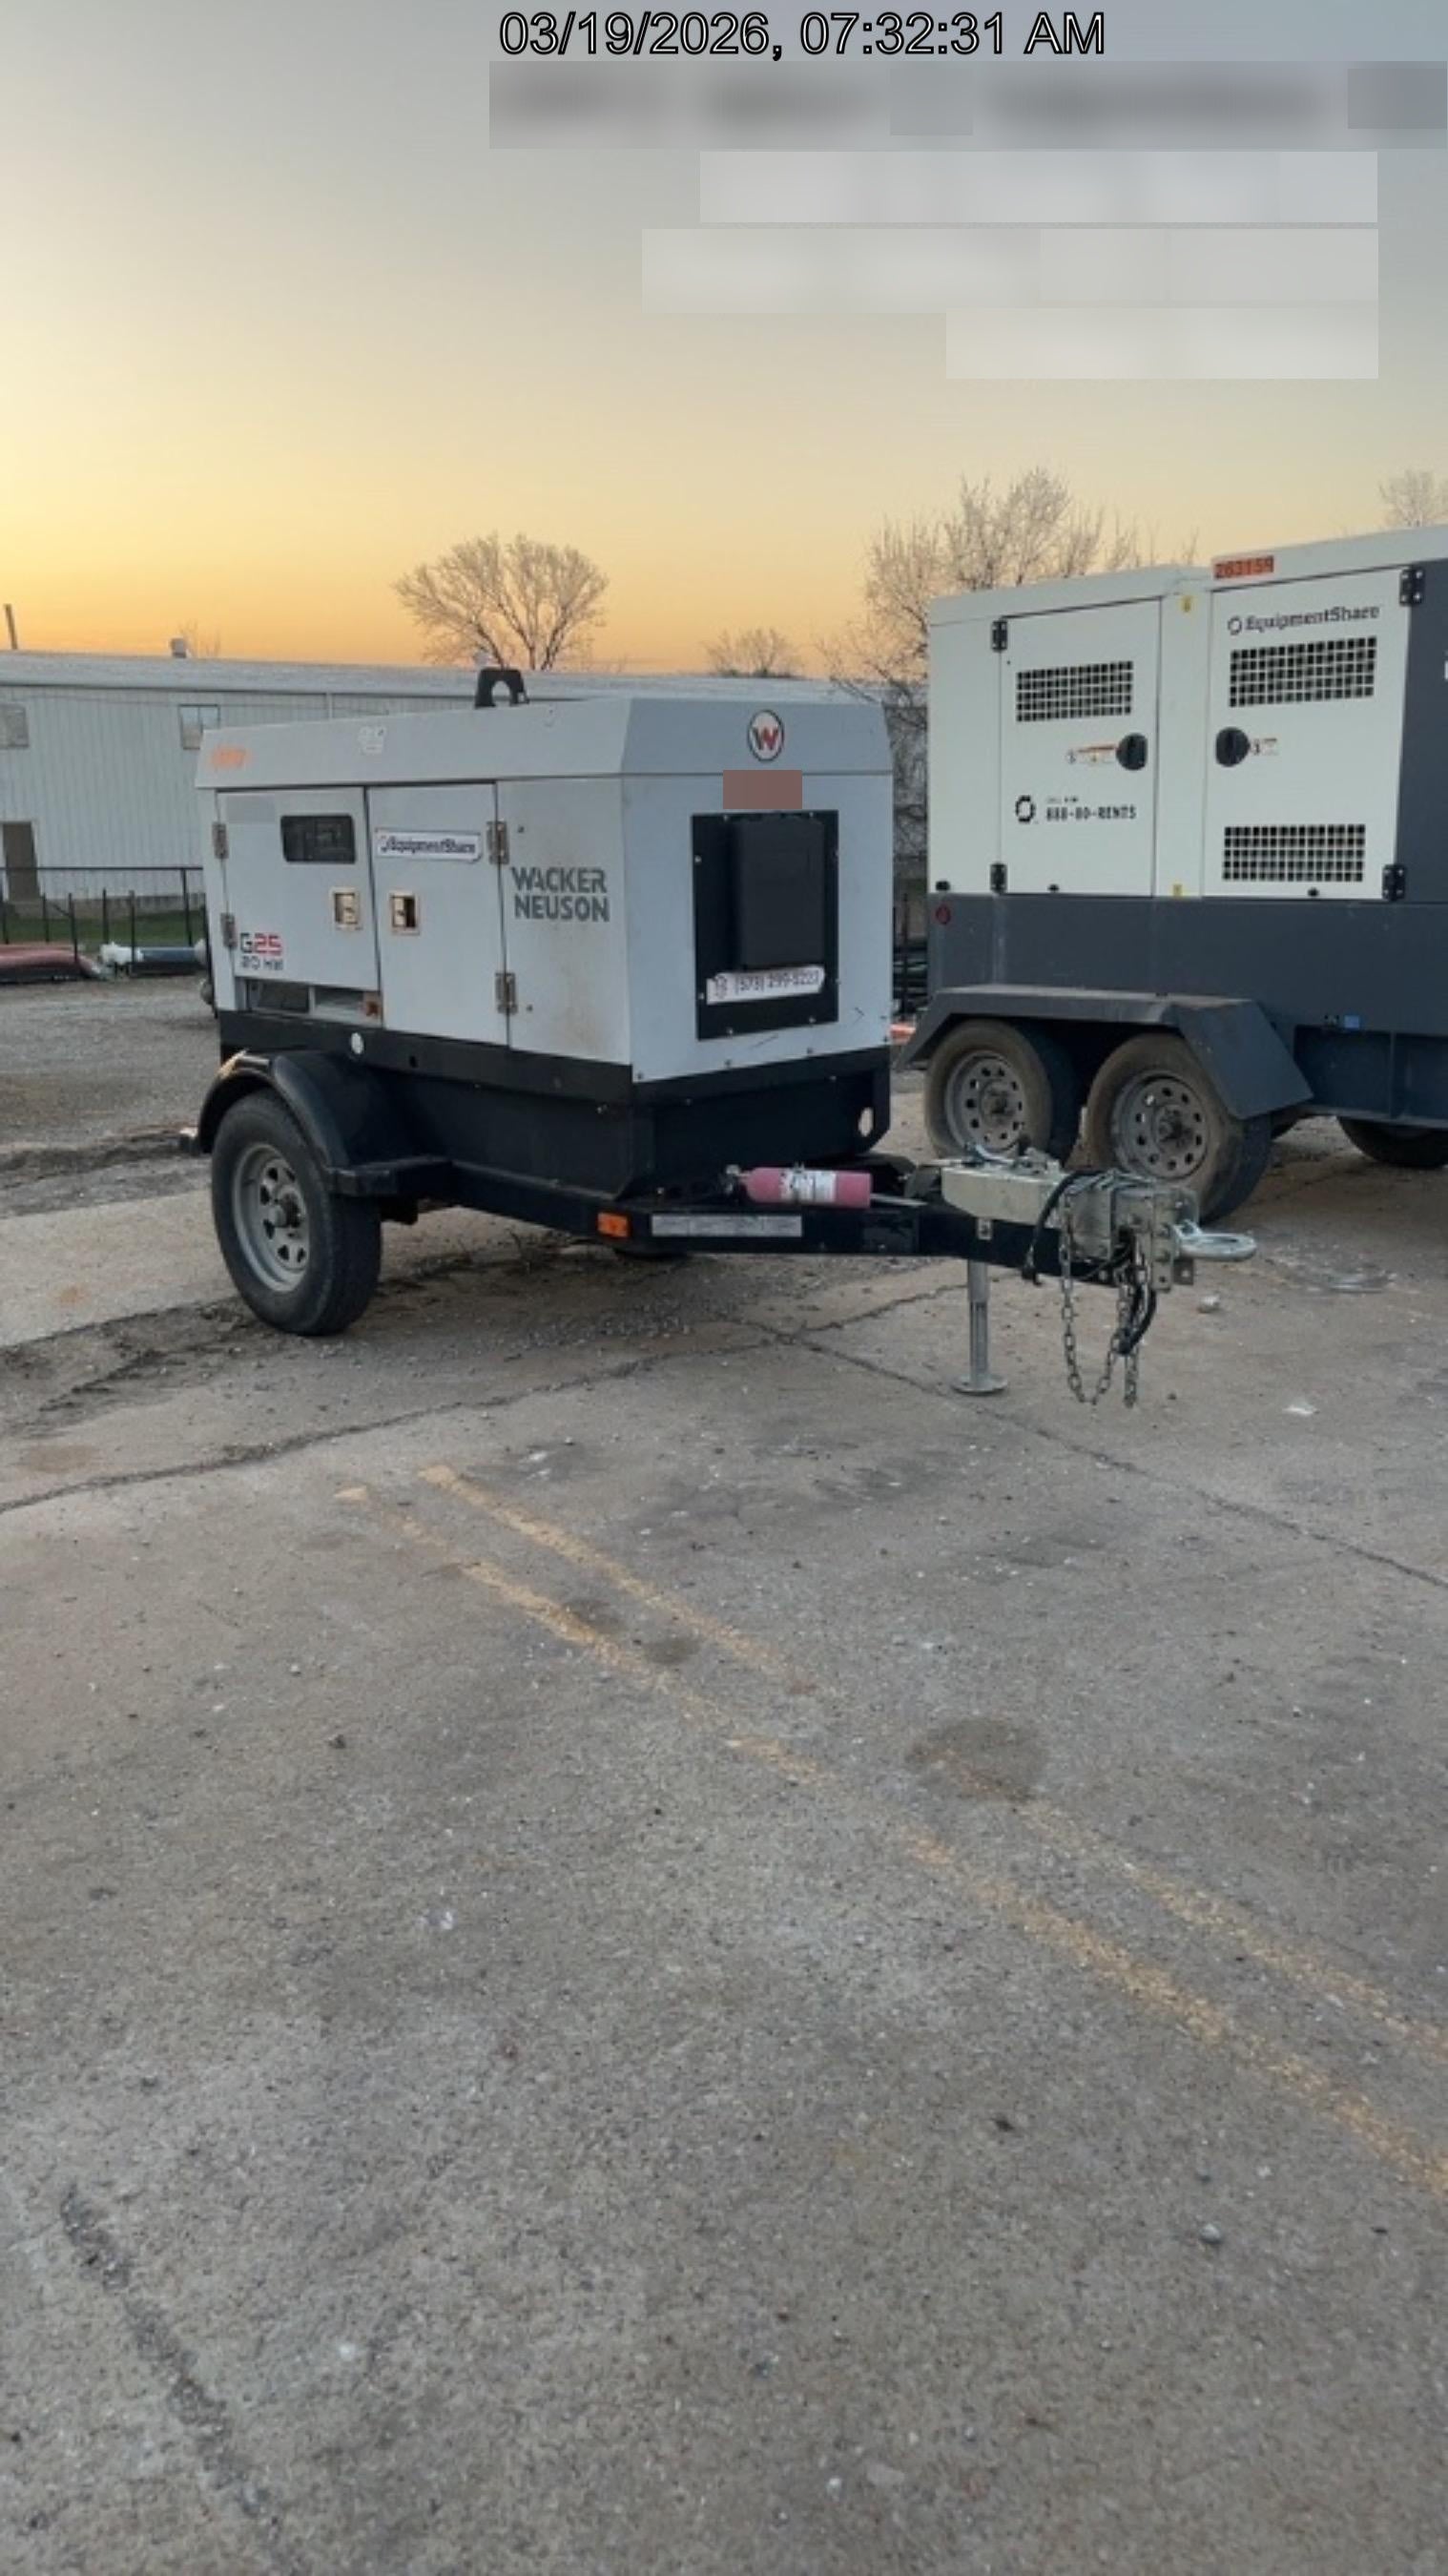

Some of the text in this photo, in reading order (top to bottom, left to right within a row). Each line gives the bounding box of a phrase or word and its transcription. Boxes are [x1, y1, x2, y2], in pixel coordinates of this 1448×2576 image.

[1245, 605, 1380, 633] EquipmentShare
[386, 835, 476, 854] EquipmentShare
[511, 866, 608, 893] WACKER
[514, 895, 610, 923] NEUSON
[240, 932, 282, 955] G25
